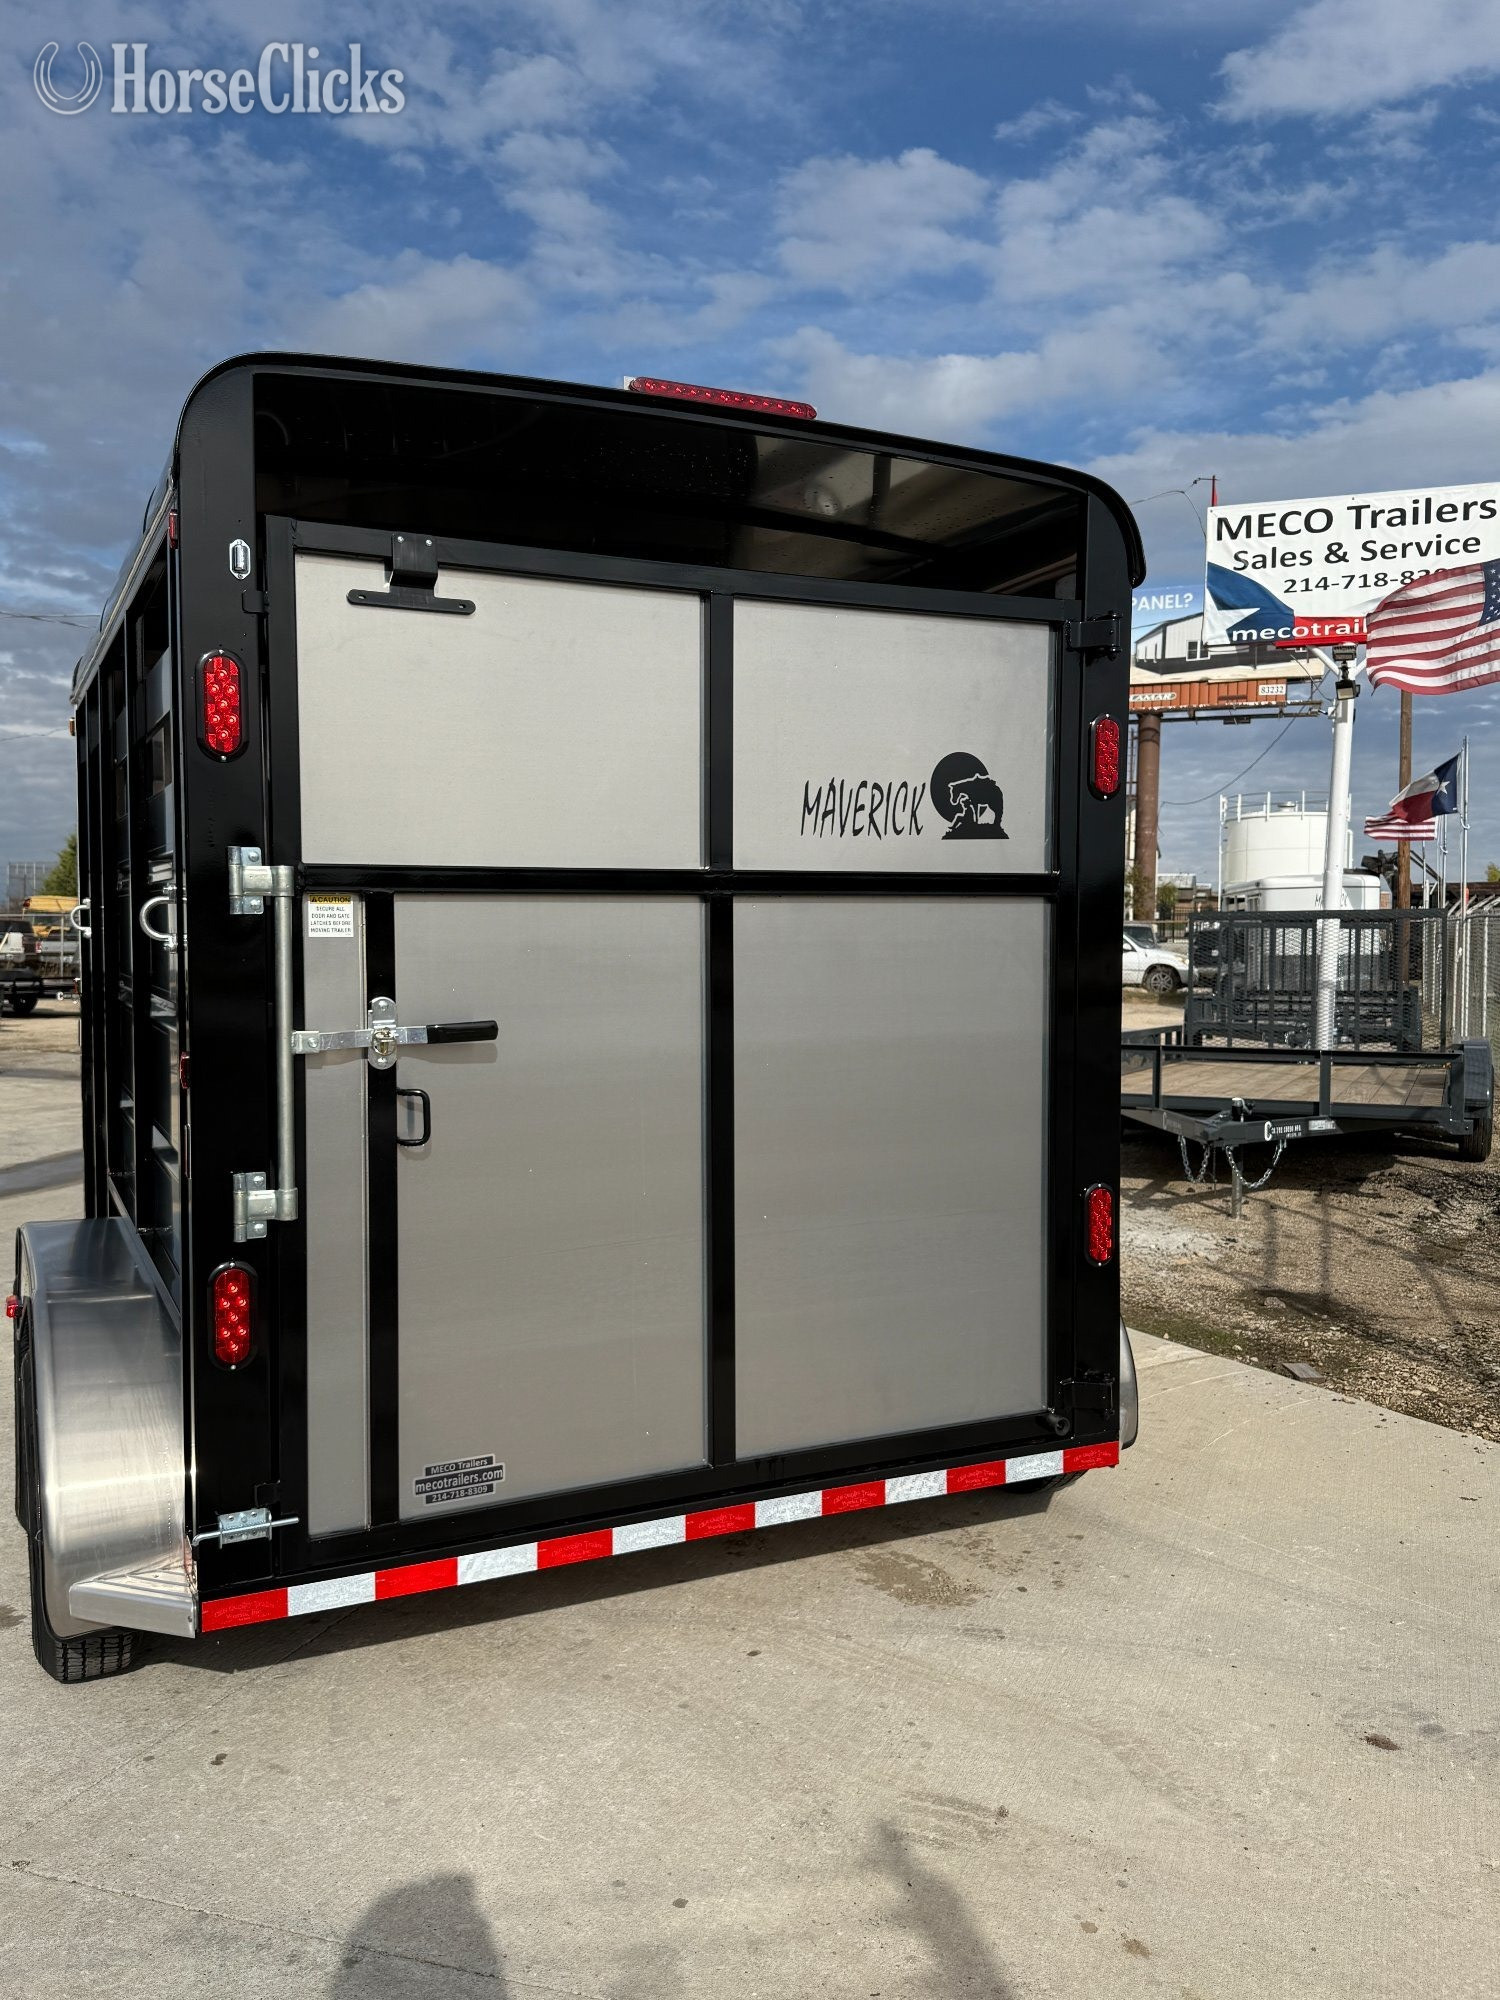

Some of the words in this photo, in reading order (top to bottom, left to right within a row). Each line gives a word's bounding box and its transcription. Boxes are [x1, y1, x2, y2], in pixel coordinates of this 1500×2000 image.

[1216, 507, 1334, 542] MECO
[1347, 496, 1497, 532] Trailers
[1232, 546, 1313, 572] Sales
[1323, 542, 1350, 564] &
[1360, 533, 1482, 562] Service
[1260, 685, 1285, 695] 83232
[800, 776, 927, 841] MAVERICK
[430, 1463, 456, 1475] MECO
[458, 1458, 488, 1469] Trailers
[415, 1468, 503, 1494] mecotrailers.com
[431, 1485, 488, 1502] 214-718-8309
